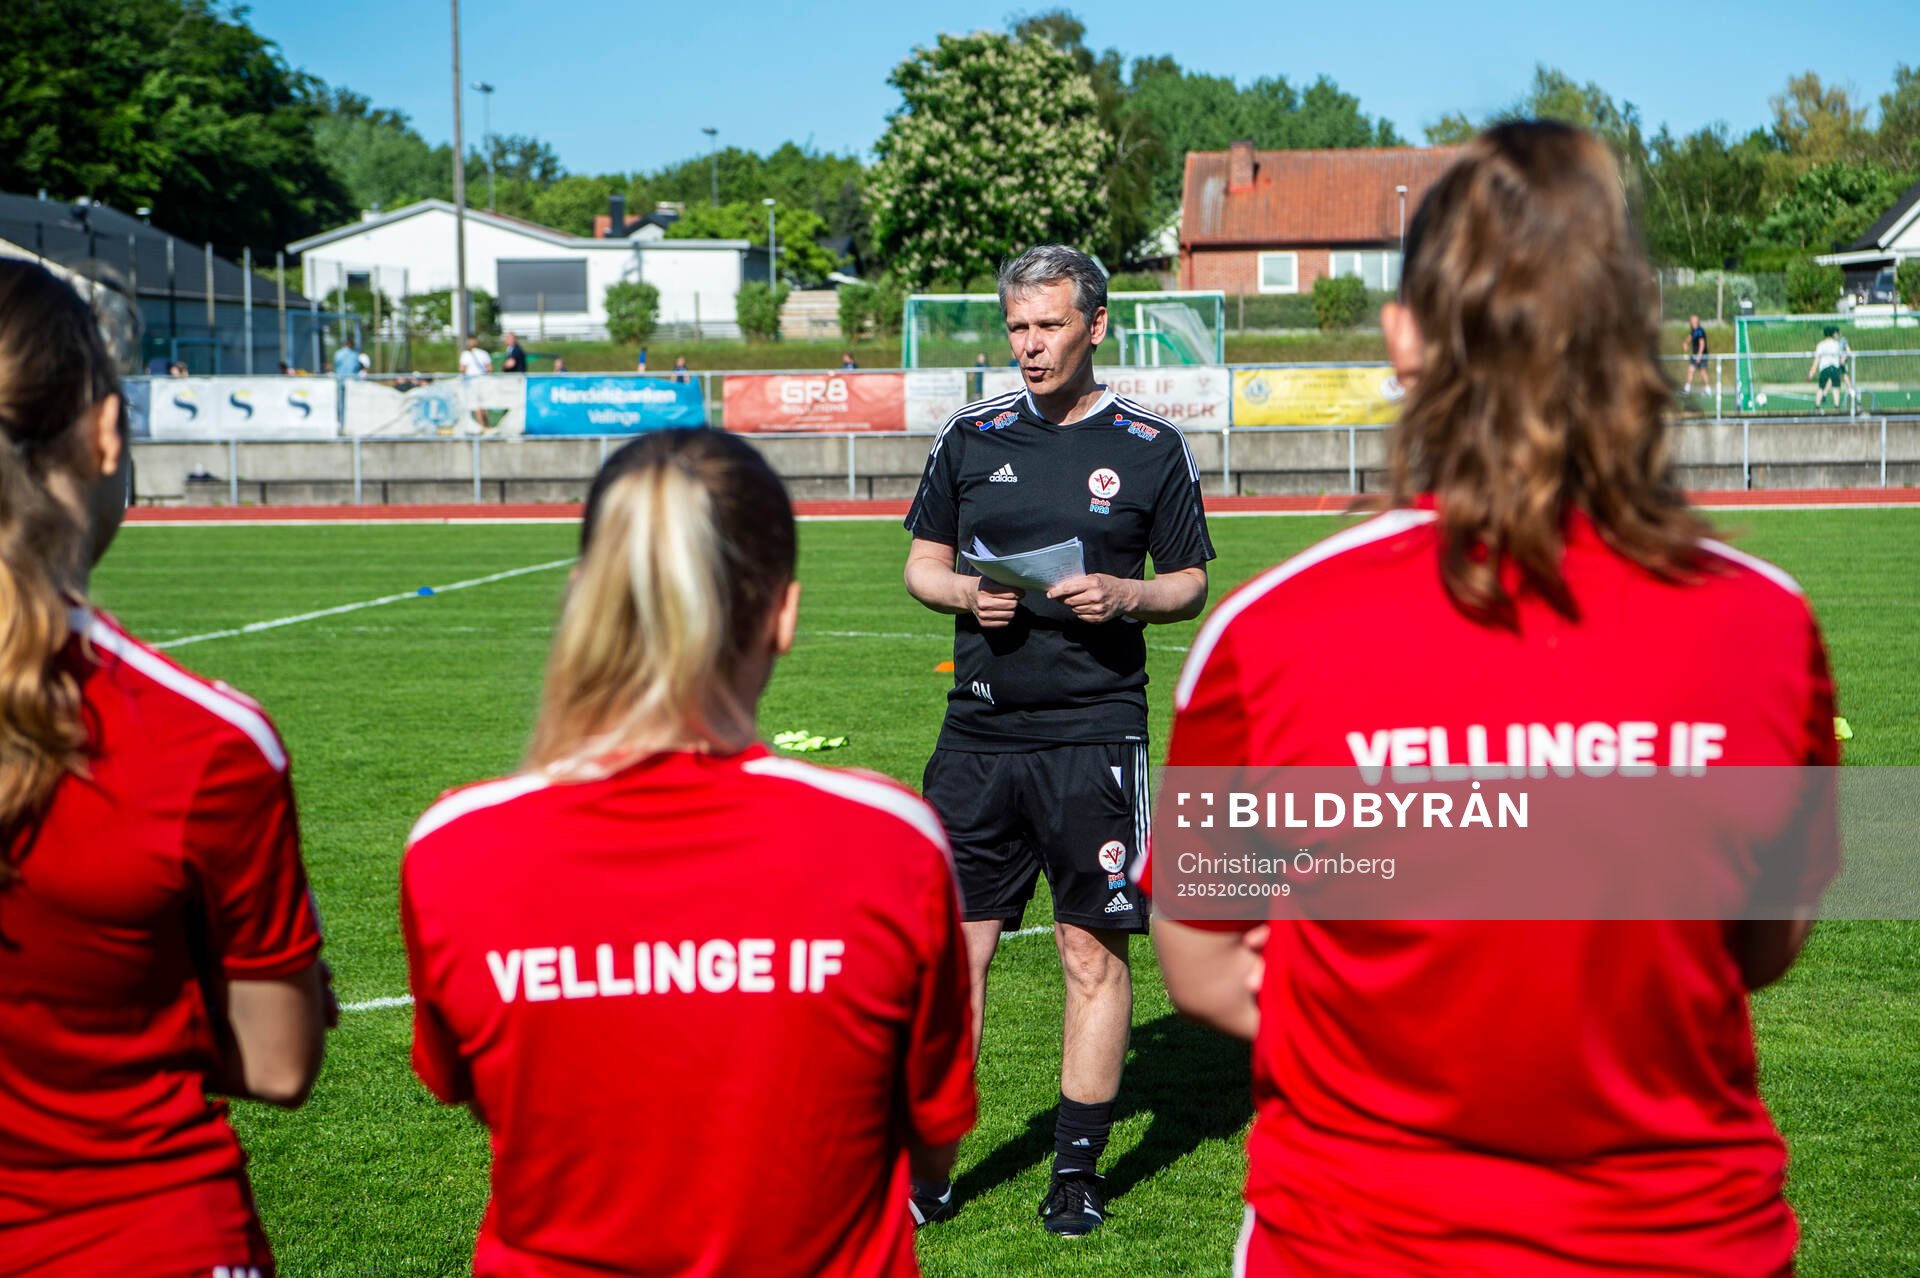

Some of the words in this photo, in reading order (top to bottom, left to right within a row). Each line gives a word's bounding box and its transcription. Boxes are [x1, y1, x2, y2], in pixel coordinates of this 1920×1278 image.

[781, 379, 848, 404] GR8
[989, 474, 1018, 483] adidas
[1346, 721, 1659, 787] VELLINGE
[1669, 721, 1727, 778] IF
[1104, 903, 1133, 913] adidas
[485, 938, 776, 1004] VELLINGE
[789, 938, 845, 994] IF
